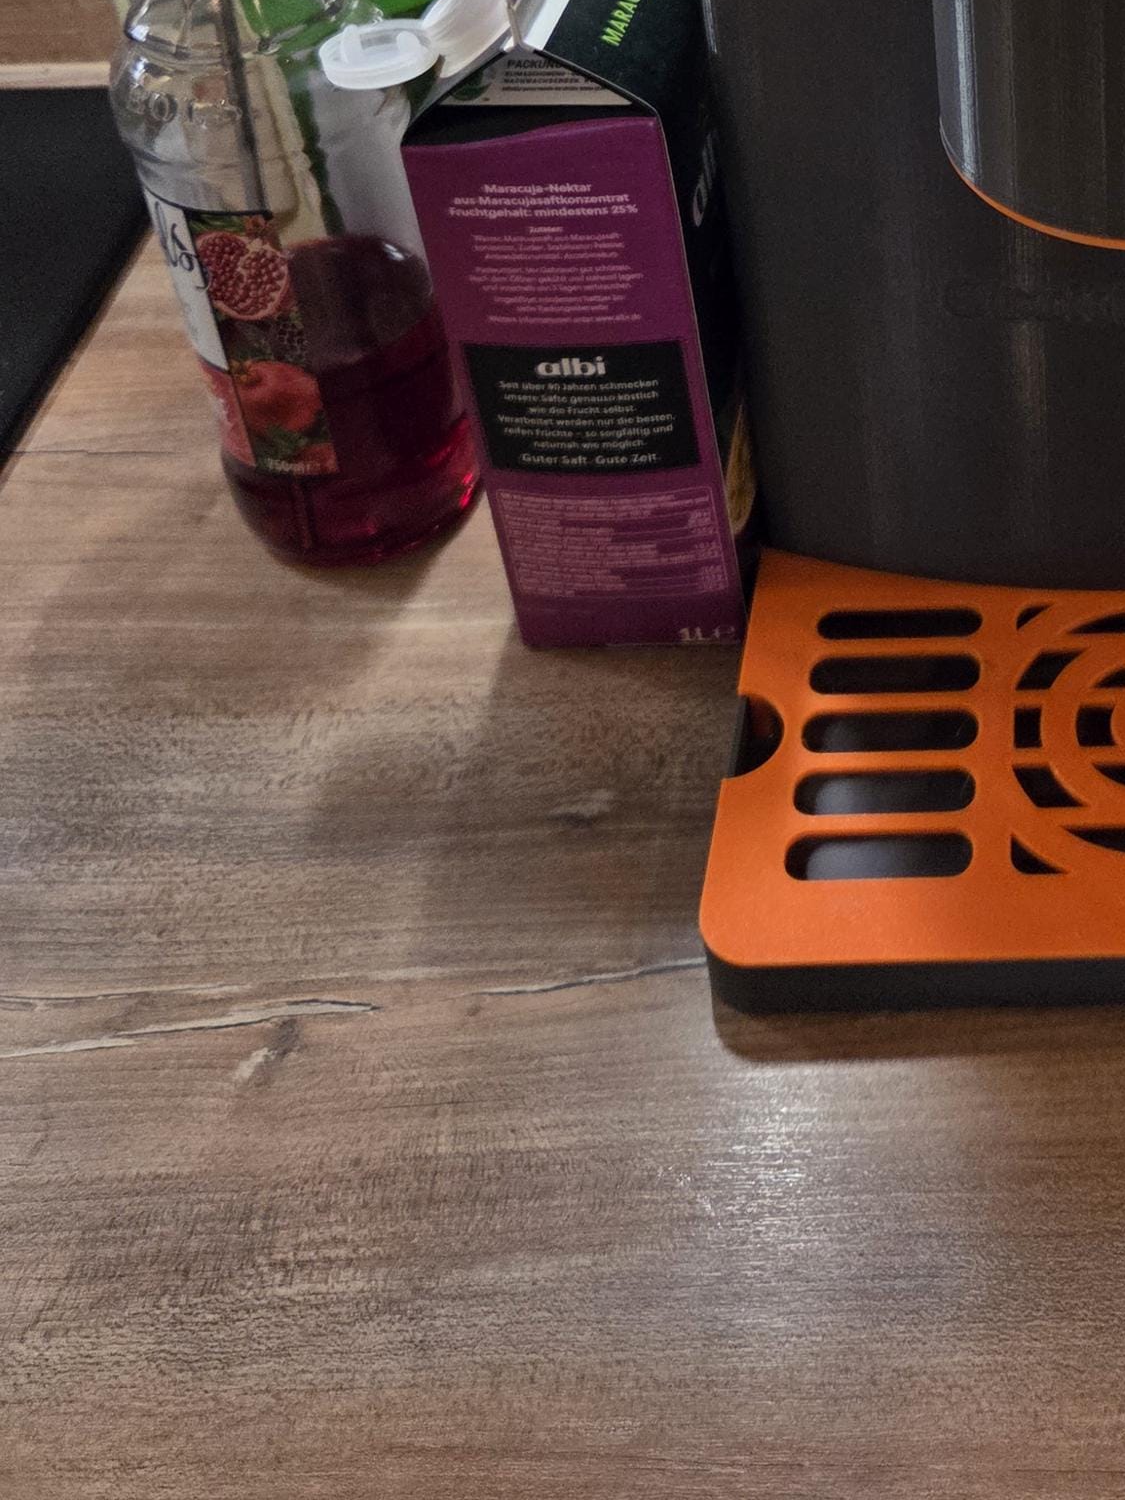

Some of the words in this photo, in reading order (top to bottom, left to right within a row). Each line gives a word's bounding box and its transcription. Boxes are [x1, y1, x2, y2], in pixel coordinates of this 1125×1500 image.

[484, 183, 592, 196] Maracuja-Nektar
[454, 196, 476, 205] aus
[479, 193, 630, 207] Maracujasaftkonzentrat
[449, 207, 532, 219] Fruchtgehalt:
[535, 206, 609, 218] mindestens
[611, 204, 639, 215] 25%
[535, 355, 607, 377] albi
[599, 379, 659, 390] schmecken
[567, 405, 600, 415] Frucht
[556, 416, 595, 427] werden
[597, 417, 615, 426] nur
[653, 424, 674, 435] und
[521, 453, 558, 465] Guter
[595, 453, 628, 465] Gute
